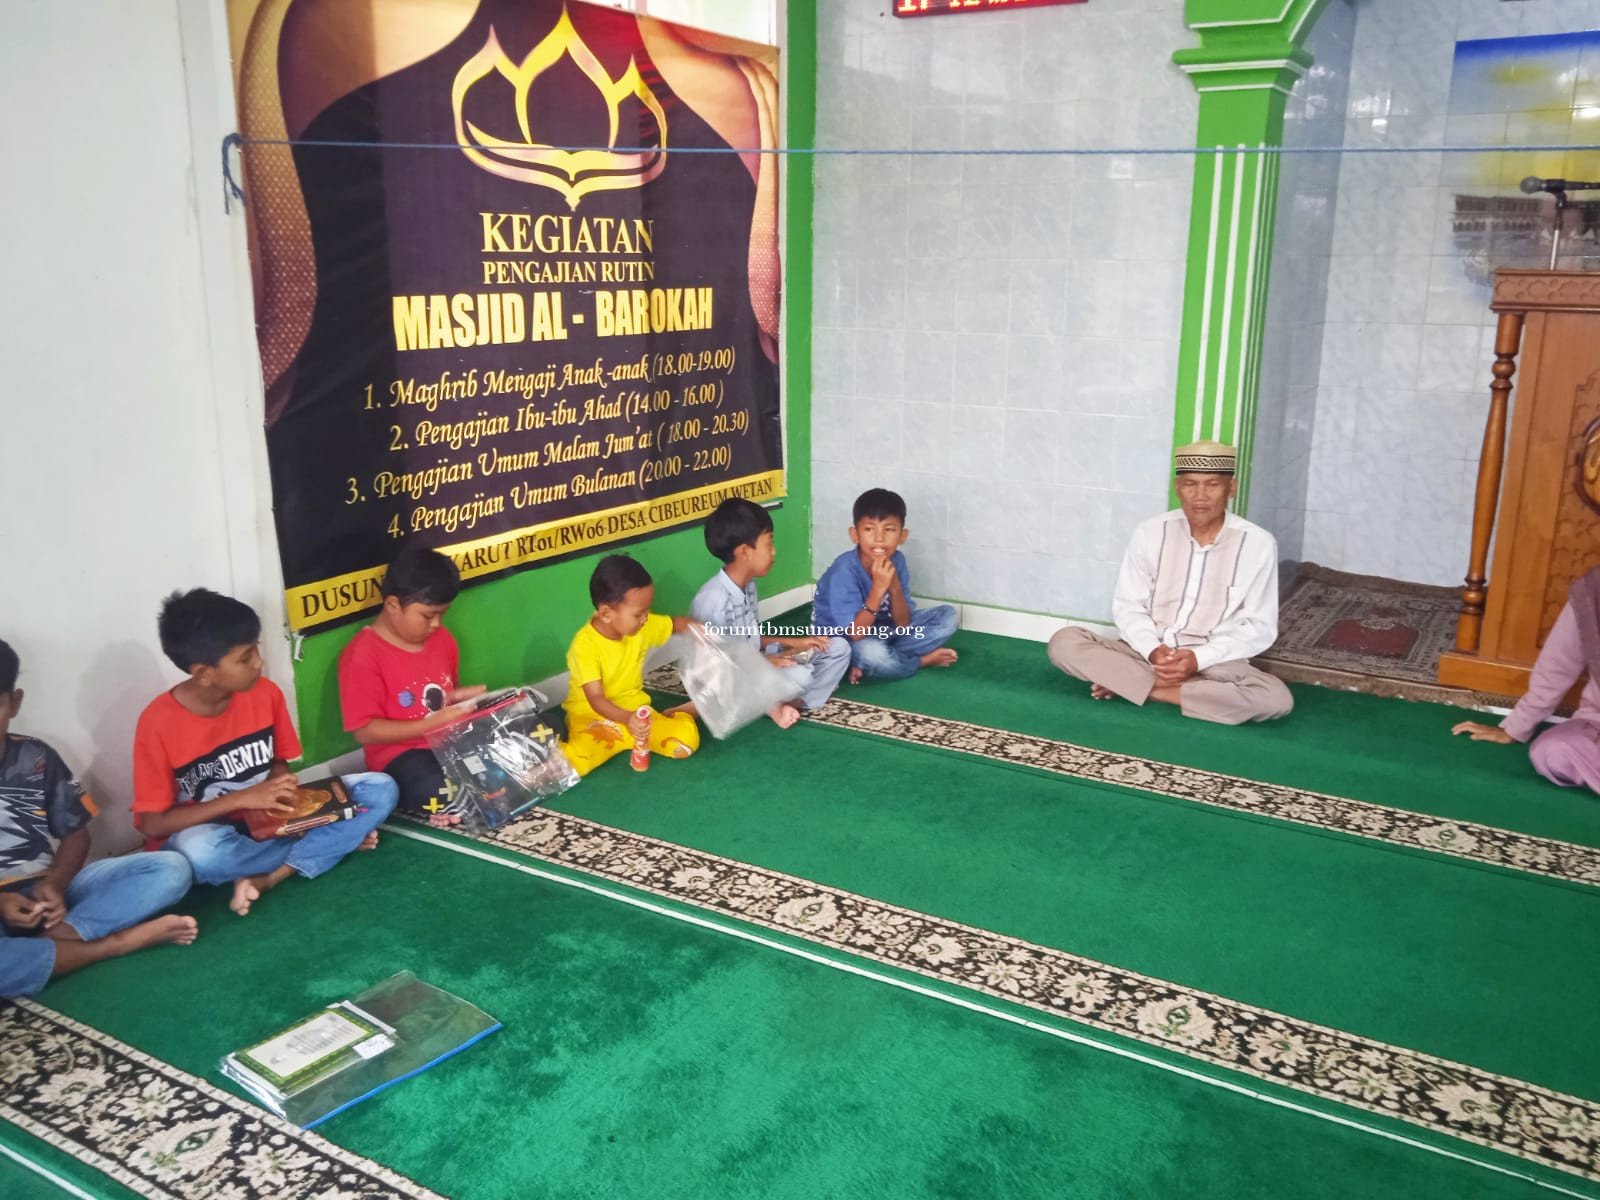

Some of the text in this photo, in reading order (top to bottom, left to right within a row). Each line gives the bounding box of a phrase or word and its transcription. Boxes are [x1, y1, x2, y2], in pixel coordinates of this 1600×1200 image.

[479, 212, 654, 254] KEGIATAN
[482, 261, 655, 284] PENGAJIAN RUTIN
[392, 293, 526, 351] MASJID
[532, 291, 568, 342] AL
[595, 287, 713, 338] BAROKAH
[363, 384, 381, 410] 1.
[389, 368, 478, 412] Maghrib
[482, 364, 556, 400] Mengaji
[390, 425, 409, 451] 2.
[416, 411, 510, 450] Pengajian
[515, 400, 577, 432] Ibu-ibu
[578, 391, 626, 426] Ahad
[345, 477, 366, 505] 3.
[374, 458, 474, 500] Pengajian
[478, 448, 540, 476] Umum
[543, 434, 600, 466] Malam
[602, 425, 654, 460] Jum'at
[711, 408, 750, 437] 20.30)
[387, 513, 405, 539] 4.
[411, 492, 505, 532] Pengajian
[510, 481, 567, 510] Umum
[571, 467, 636, 498] Bulanan
[693, 443, 732, 472] 22.00)
[454, 540, 513, 572] ARUT
[607, 510, 647, 535] DESA
[648, 488, 728, 525] CIBEUREUM
[731, 477, 772, 499] WETAN
